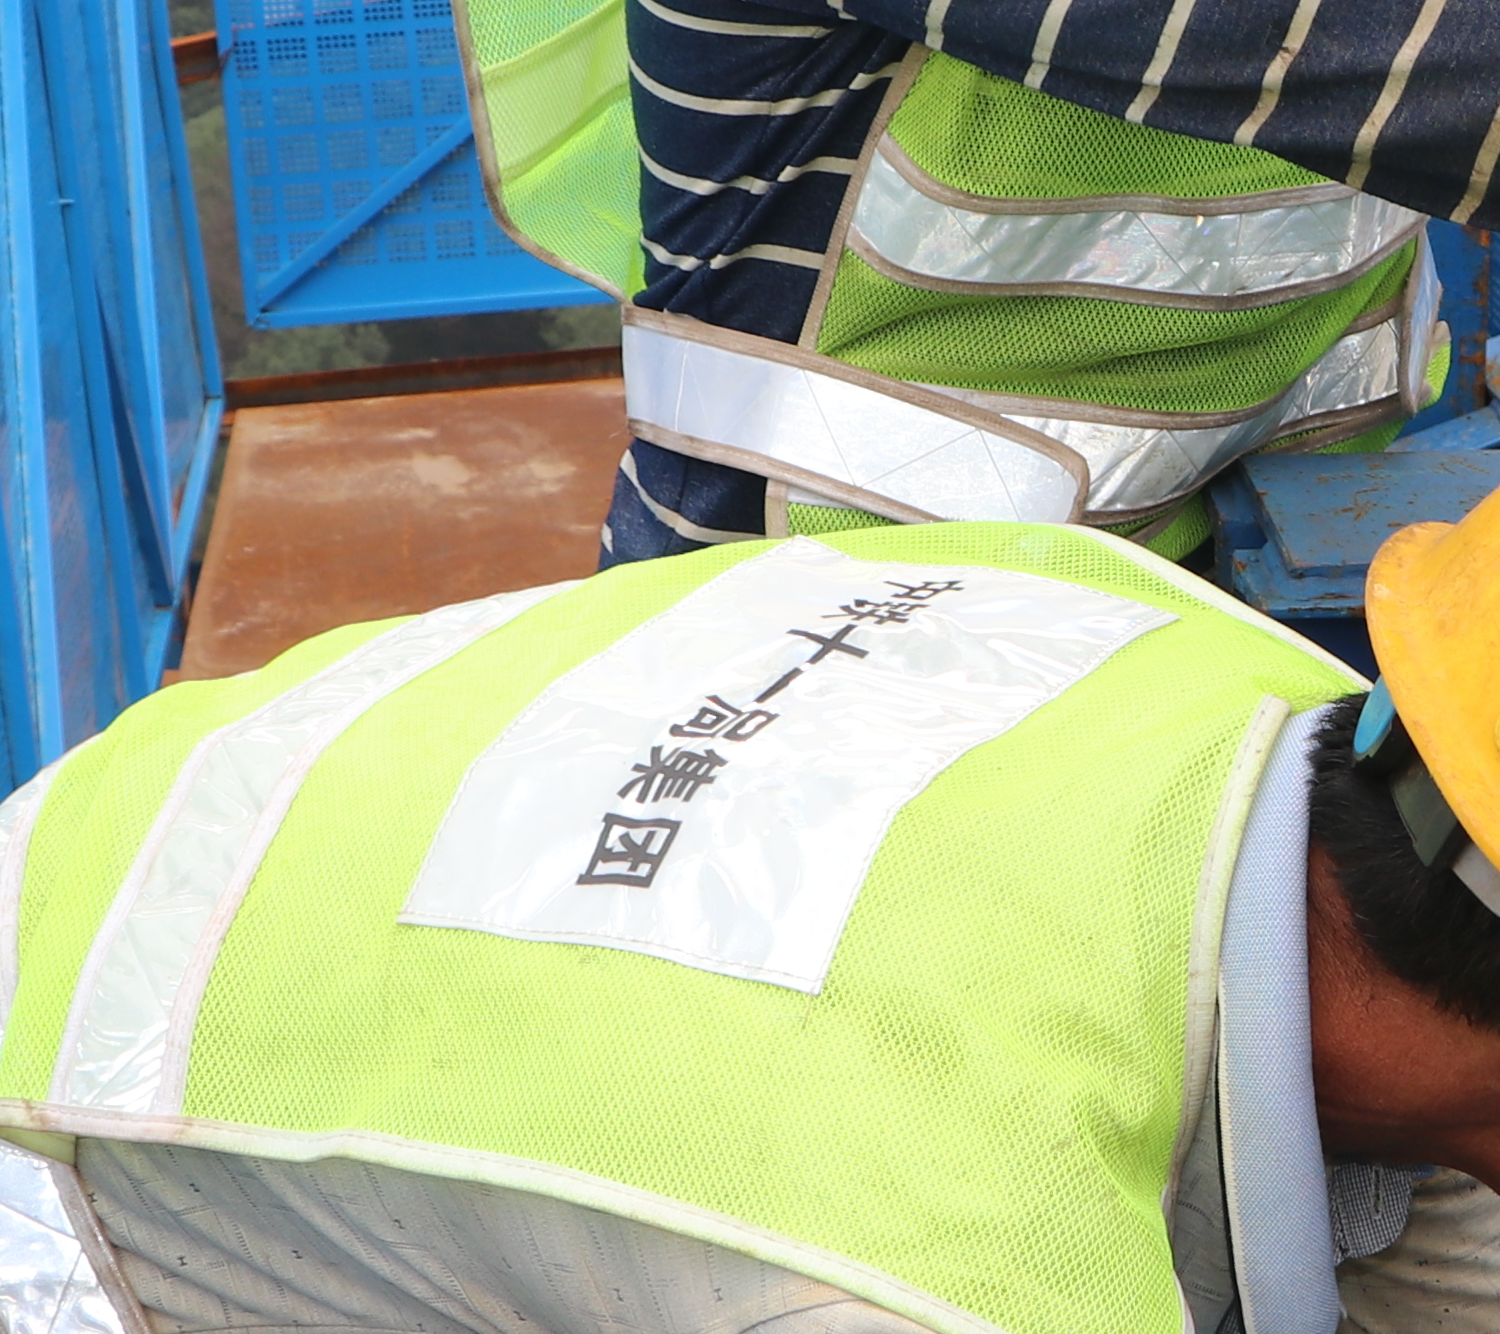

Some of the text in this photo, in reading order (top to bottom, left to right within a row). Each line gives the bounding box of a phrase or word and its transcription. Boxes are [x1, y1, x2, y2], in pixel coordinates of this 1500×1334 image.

[575, 578, 965, 889] 中铁十一局集团
